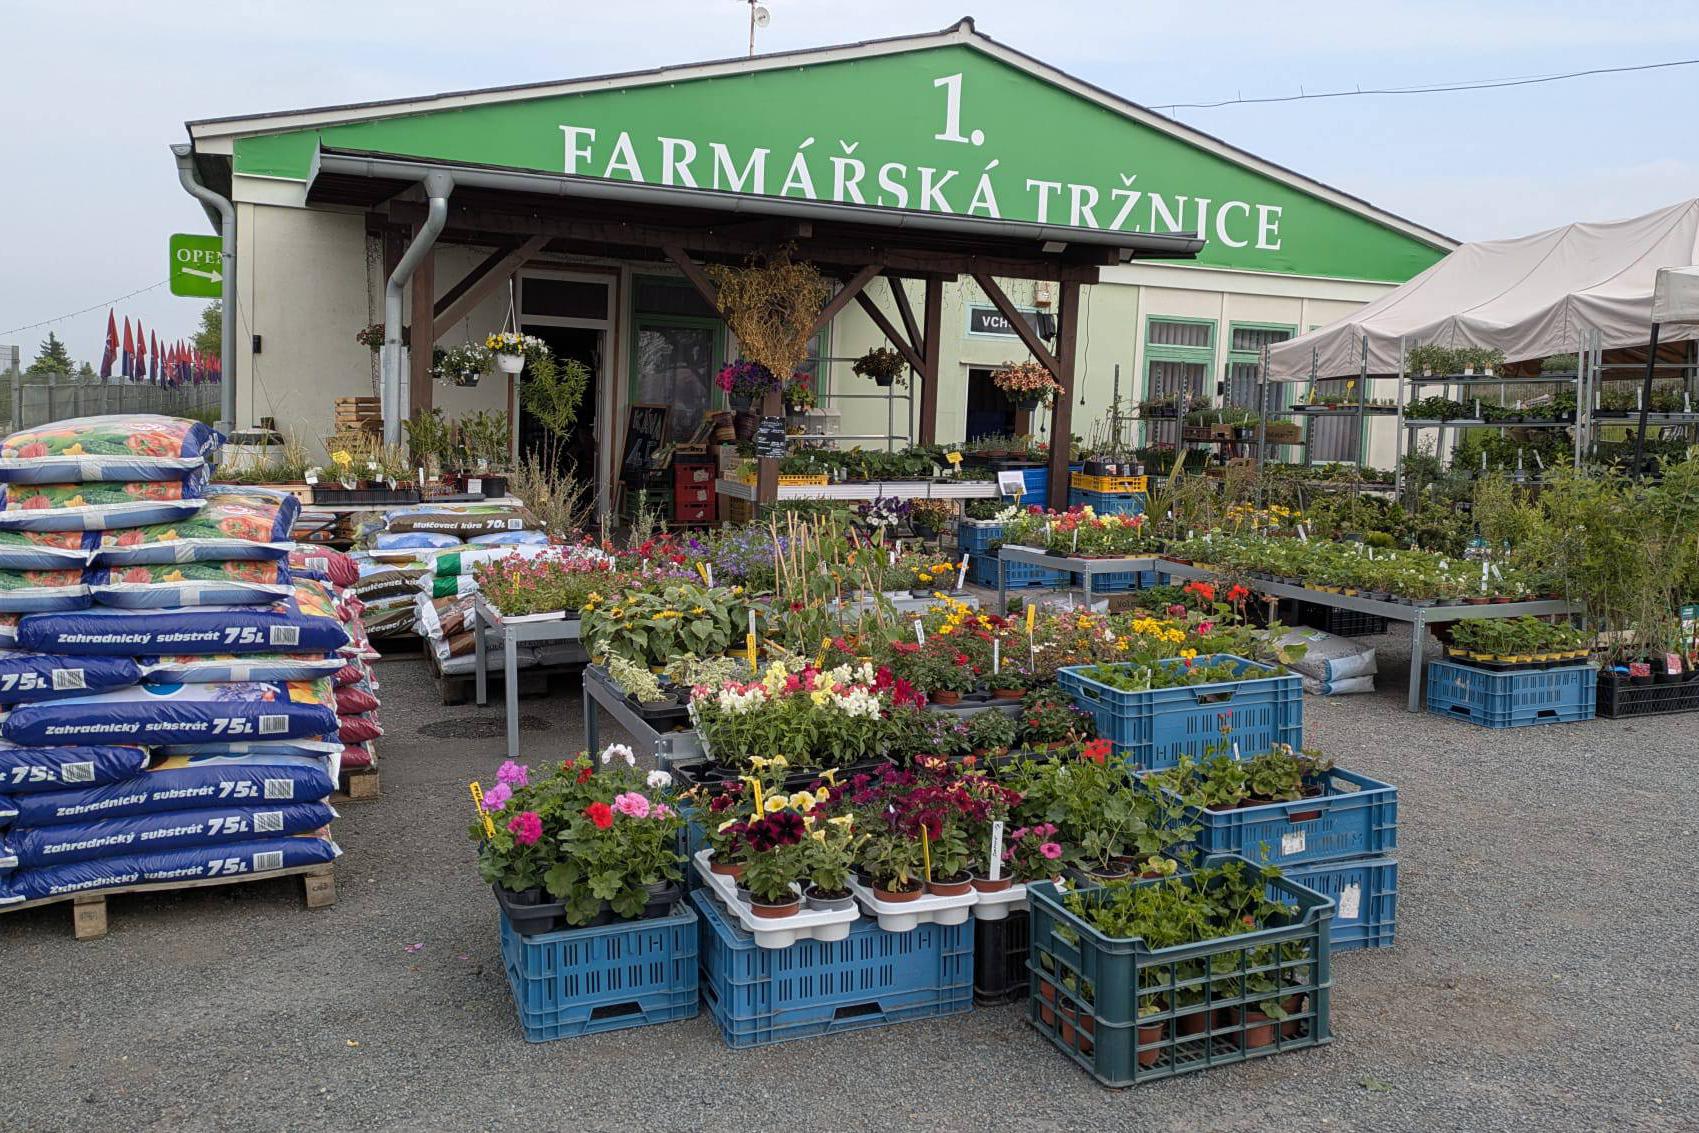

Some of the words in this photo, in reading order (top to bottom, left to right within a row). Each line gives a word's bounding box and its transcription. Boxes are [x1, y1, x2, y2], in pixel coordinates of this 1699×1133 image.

[933, 72, 985, 147] 1.
[558, 124, 1002, 219] FARMÁŘSKÁ
[1025, 172, 1284, 250] TRŽNICE
[58, 632, 151, 644] Zahradnický
[156, 630, 219, 642] substrát
[223, 627, 265, 643] 75L
[1, 673, 47, 691] 75L
[46, 722, 139, 735] Zahradnický
[146, 720, 208, 732] substrát
[212, 718, 253, 734] 75L
[57, 792, 148, 817] Zahradnický
[153, 787, 214, 801] substrát
[219, 781, 259, 798] 75L
[43, 832, 135, 853] Zahradnický
[141, 823, 202, 840] substrát
[207, 817, 249, 835] 75L
[207, 858, 248, 875] 75L
